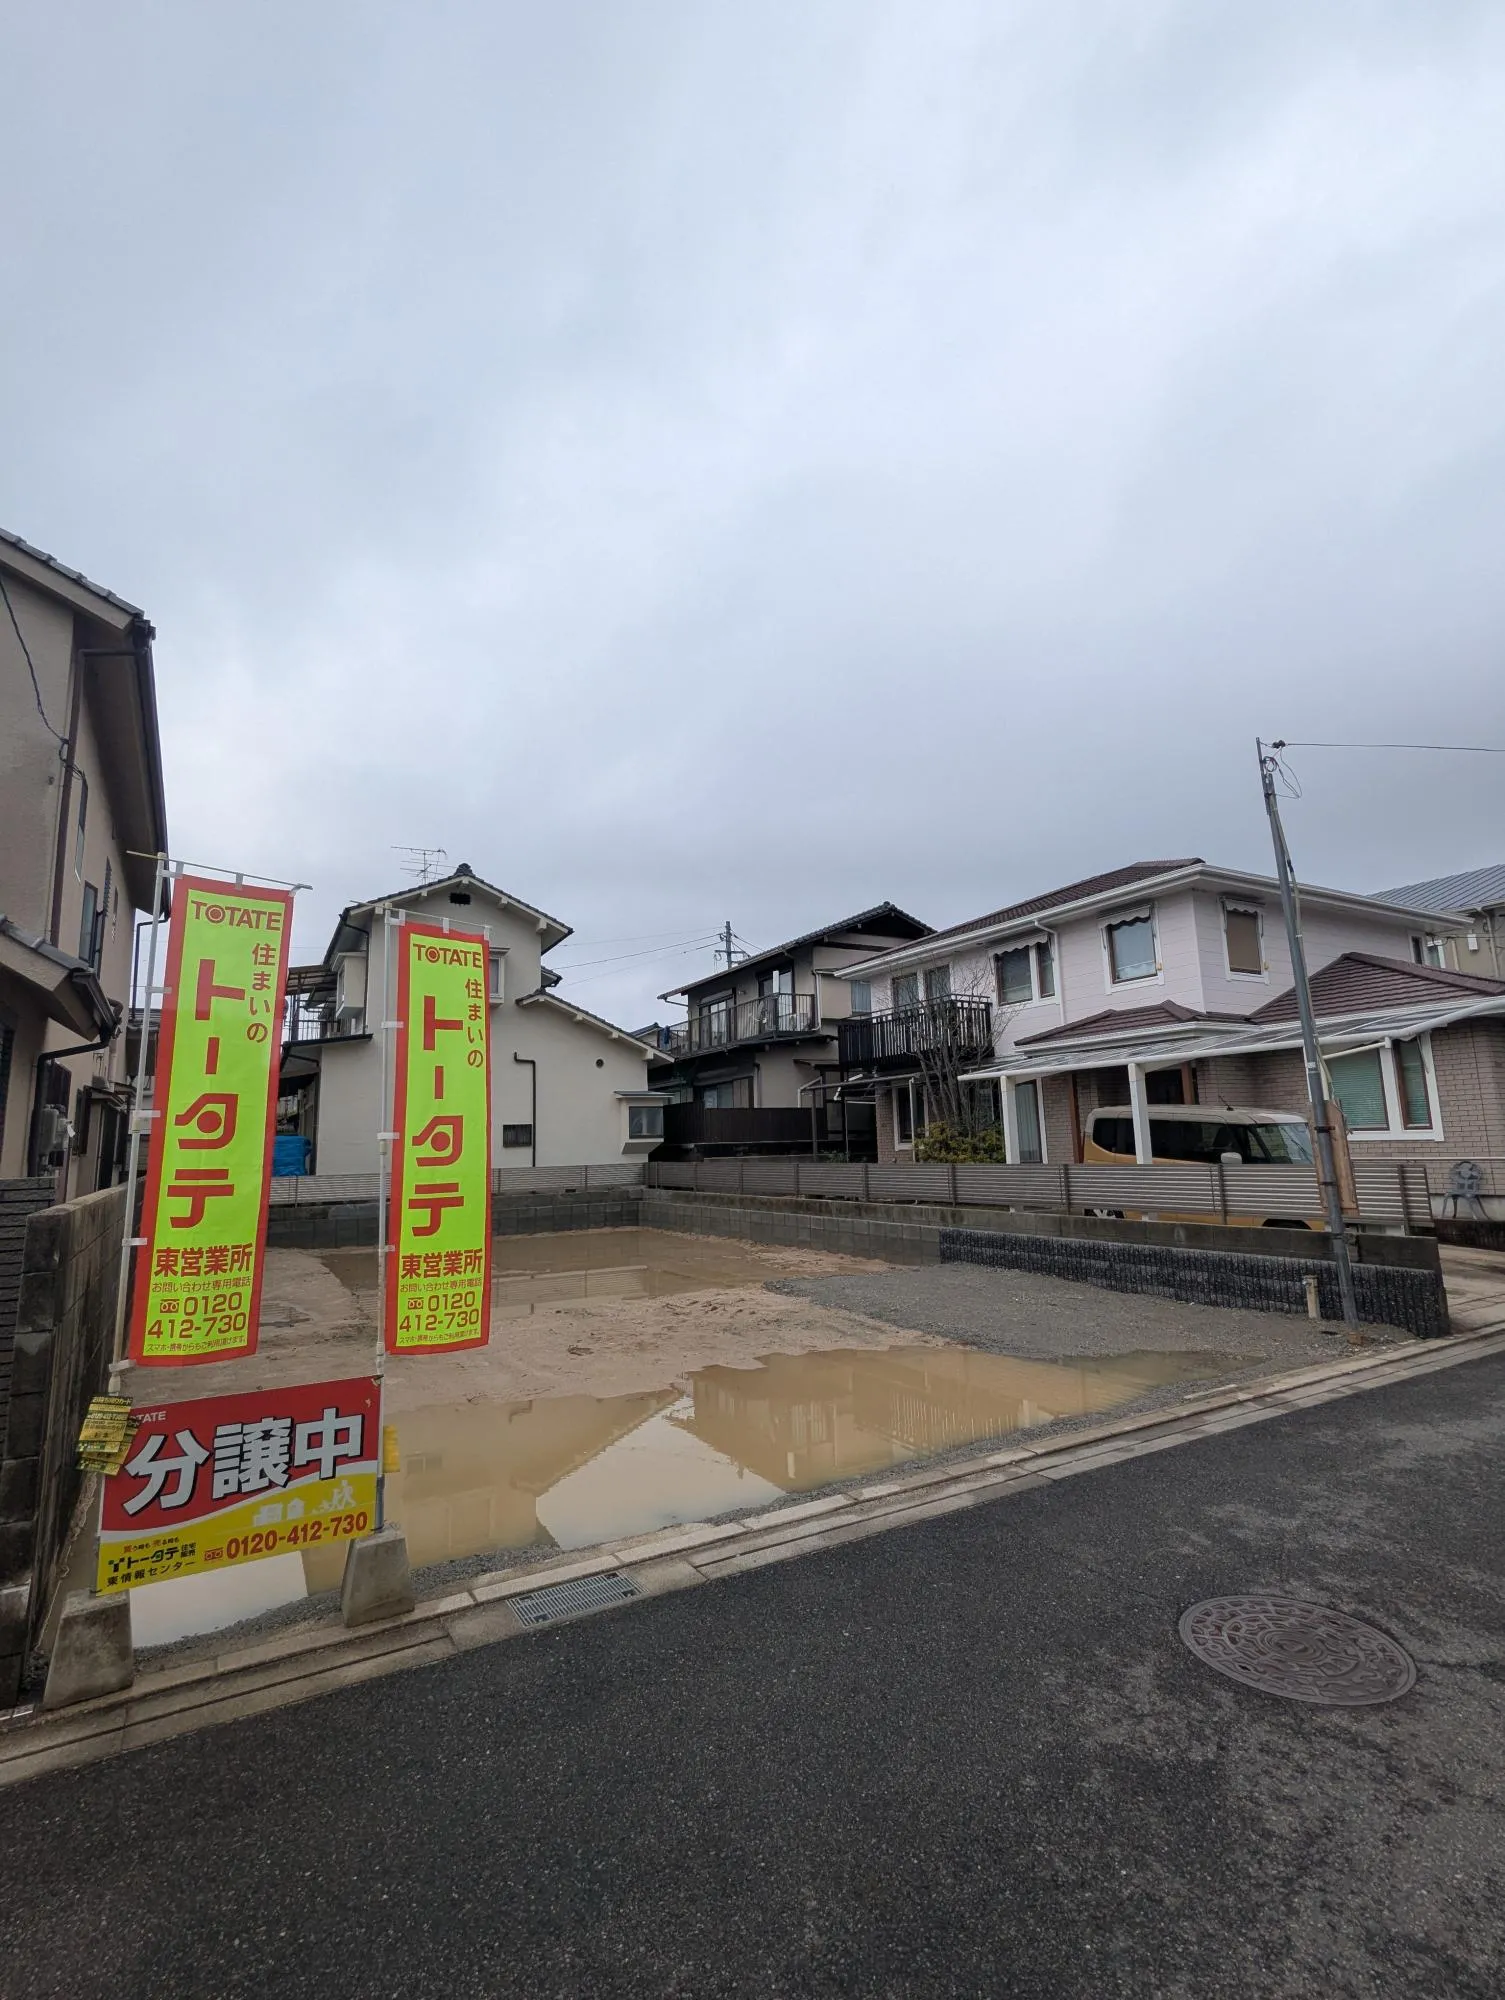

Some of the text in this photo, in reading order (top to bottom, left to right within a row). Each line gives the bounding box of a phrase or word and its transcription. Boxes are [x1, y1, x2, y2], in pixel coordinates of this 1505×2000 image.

[191, 900, 282, 931] TOTATE
[412, 943, 482, 969] TOTATE
[246, 943, 276, 1043] 住まいの
[465, 978, 485, 1068] 住まいの
[168, 958, 246, 1228] トータテ
[408, 996, 464, 1238] トータテ
[154, 1243, 253, 1277] 東営業所
[401, 1248, 482, 1279] 東営業所
[152, 1276, 252, 1293] お問い合わせ専用電話
[400, 1277, 482, 1293] お問い合わせ専用電話
[184, 1291, 243, 1316] 0120
[428, 1291, 475, 1312] 0120
[147, 1312, 247, 1339] 412-730
[399, 1309, 479, 1332] 412-730
[130, 1411, 167, 1423] TATE
[123, 1407, 365, 1516] 分譲中
[226, 1512, 368, 1559] 0120-412-730
[127, 1546, 179, 1569] トータテ
[106, 1562, 196, 1587] 東情報センター
